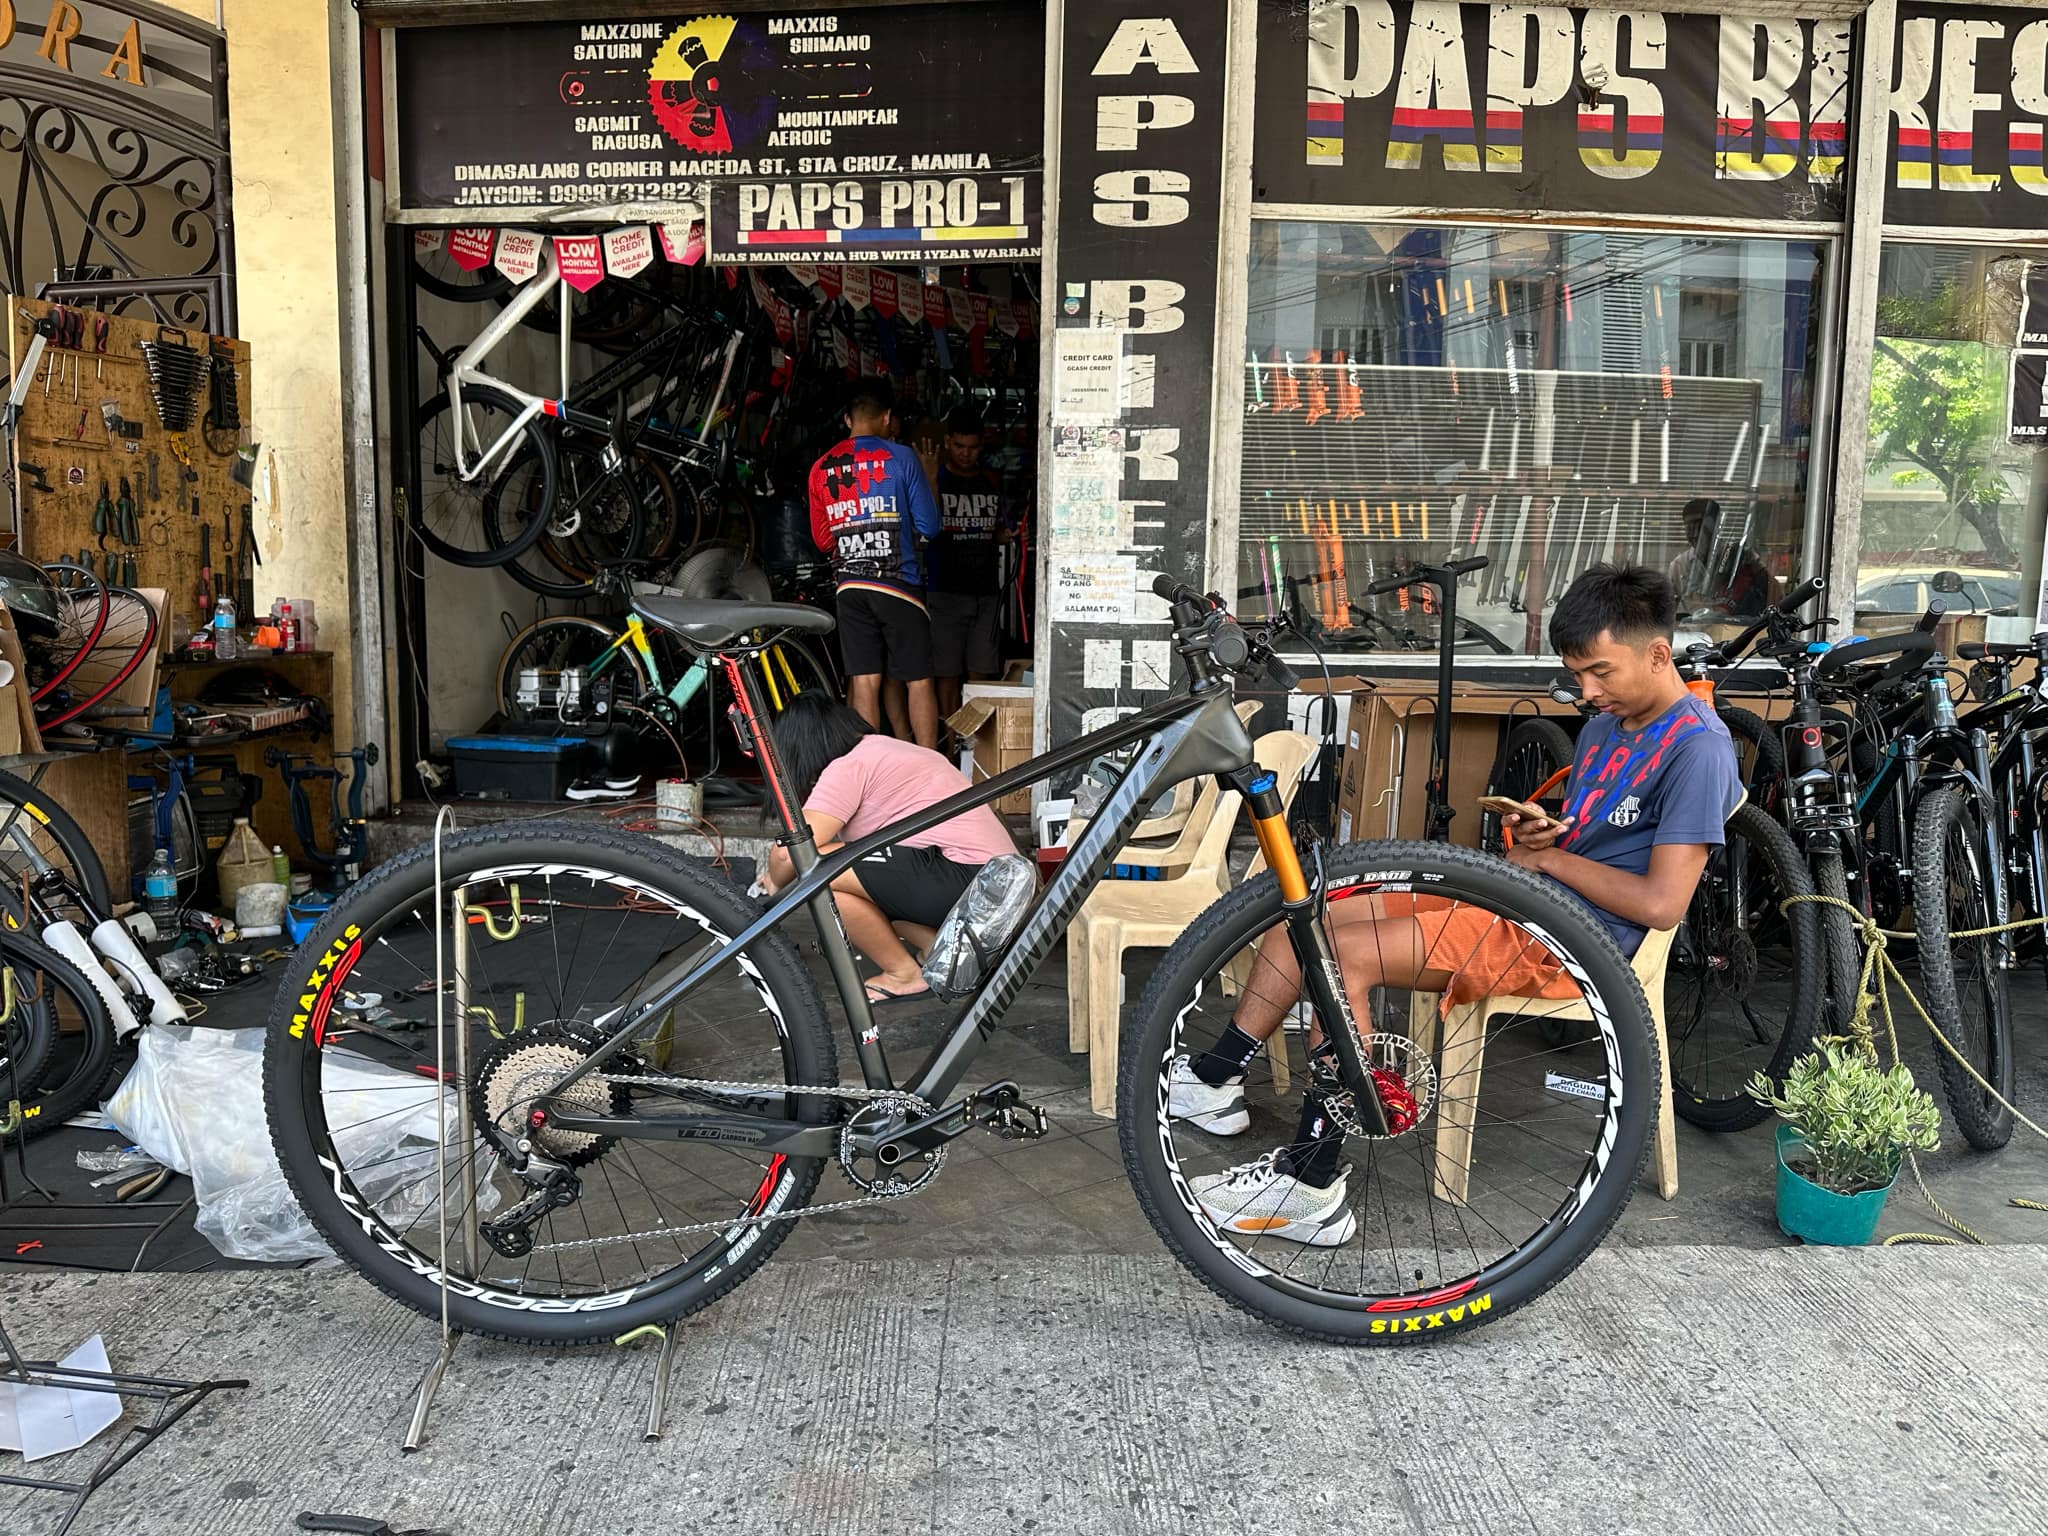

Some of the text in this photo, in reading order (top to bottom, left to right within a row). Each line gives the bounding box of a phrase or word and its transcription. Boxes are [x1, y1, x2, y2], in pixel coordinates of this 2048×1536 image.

[581, 23, 663, 40] MAXZONE
[768, 16, 839, 35] MAXXIS
[574, 43, 642, 61] SATURN
[790, 35, 871, 54] SHIMANO
[1305, 1, 1668, 181] PAPS
[575, 115, 641, 133] SAGMIT
[778, 108, 898, 128] MOUNTAINPEAK
[592, 134, 663, 151] RAGUSA
[767, 129, 832, 146] AEROIC
[455, 164, 579, 181] DIMASALANG
[586, 161, 663, 178] CORNER
[669, 159, 752, 176] MACEDA
[798, 157, 837, 174] STA
[911, 153, 991, 170] MANILA
[739, 177, 1025, 231] PAPS PRO-1
[453, 236, 490, 252] MONTHLY
[505, 235, 534, 247] HOME
[611, 230, 642, 247] HOME
[612, 238, 646, 255] CREDIT
[503, 243, 534, 256] CREDIT
[559, 242, 595, 258] LOW
[713, 251, 747, 262] MAS
[750, 250, 824, 262] MAINGAY
[824, 250, 844, 262] NA
[849, 249, 879, 261] HUB
[880, 248, 922, 260] WITH
[924, 247, 970, 260] 1YEAR
[498, 256, 535, 270] AVAILABLE
[561, 259, 598, 267] MONTHLY
[611, 250, 650, 267] AVAILABLE
[622, 261, 641, 273] HERE
[507, 266, 525, 275] HERE
[942, 493, 999, 517] PAPS
[838, 529, 891, 555] PAPS
[288, 923, 361, 1040] MAXXIS
[1370, 1293, 1493, 1335] MAXXIS
